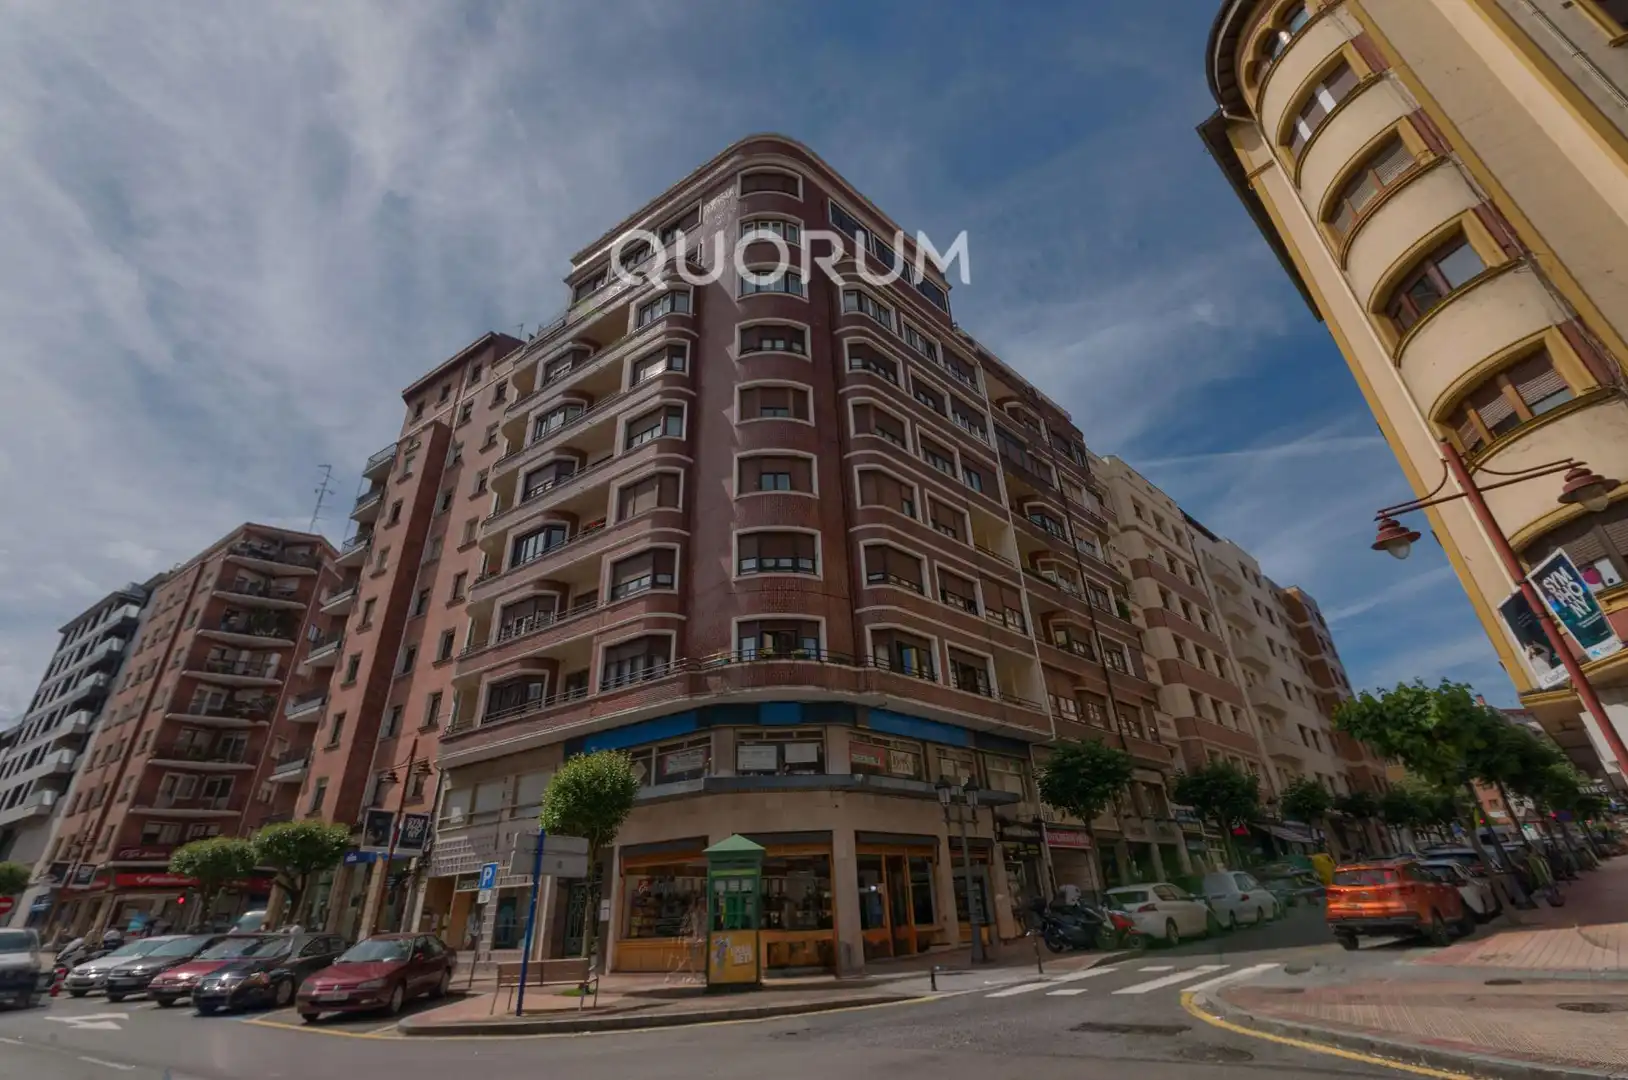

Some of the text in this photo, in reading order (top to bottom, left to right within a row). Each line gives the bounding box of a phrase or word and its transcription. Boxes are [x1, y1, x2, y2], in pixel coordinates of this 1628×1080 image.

[1543, 566, 1573, 592] SYM
[1553, 581, 1584, 608] PHO
[1569, 596, 1592, 619] NY
[482, 866, 493, 887] P
